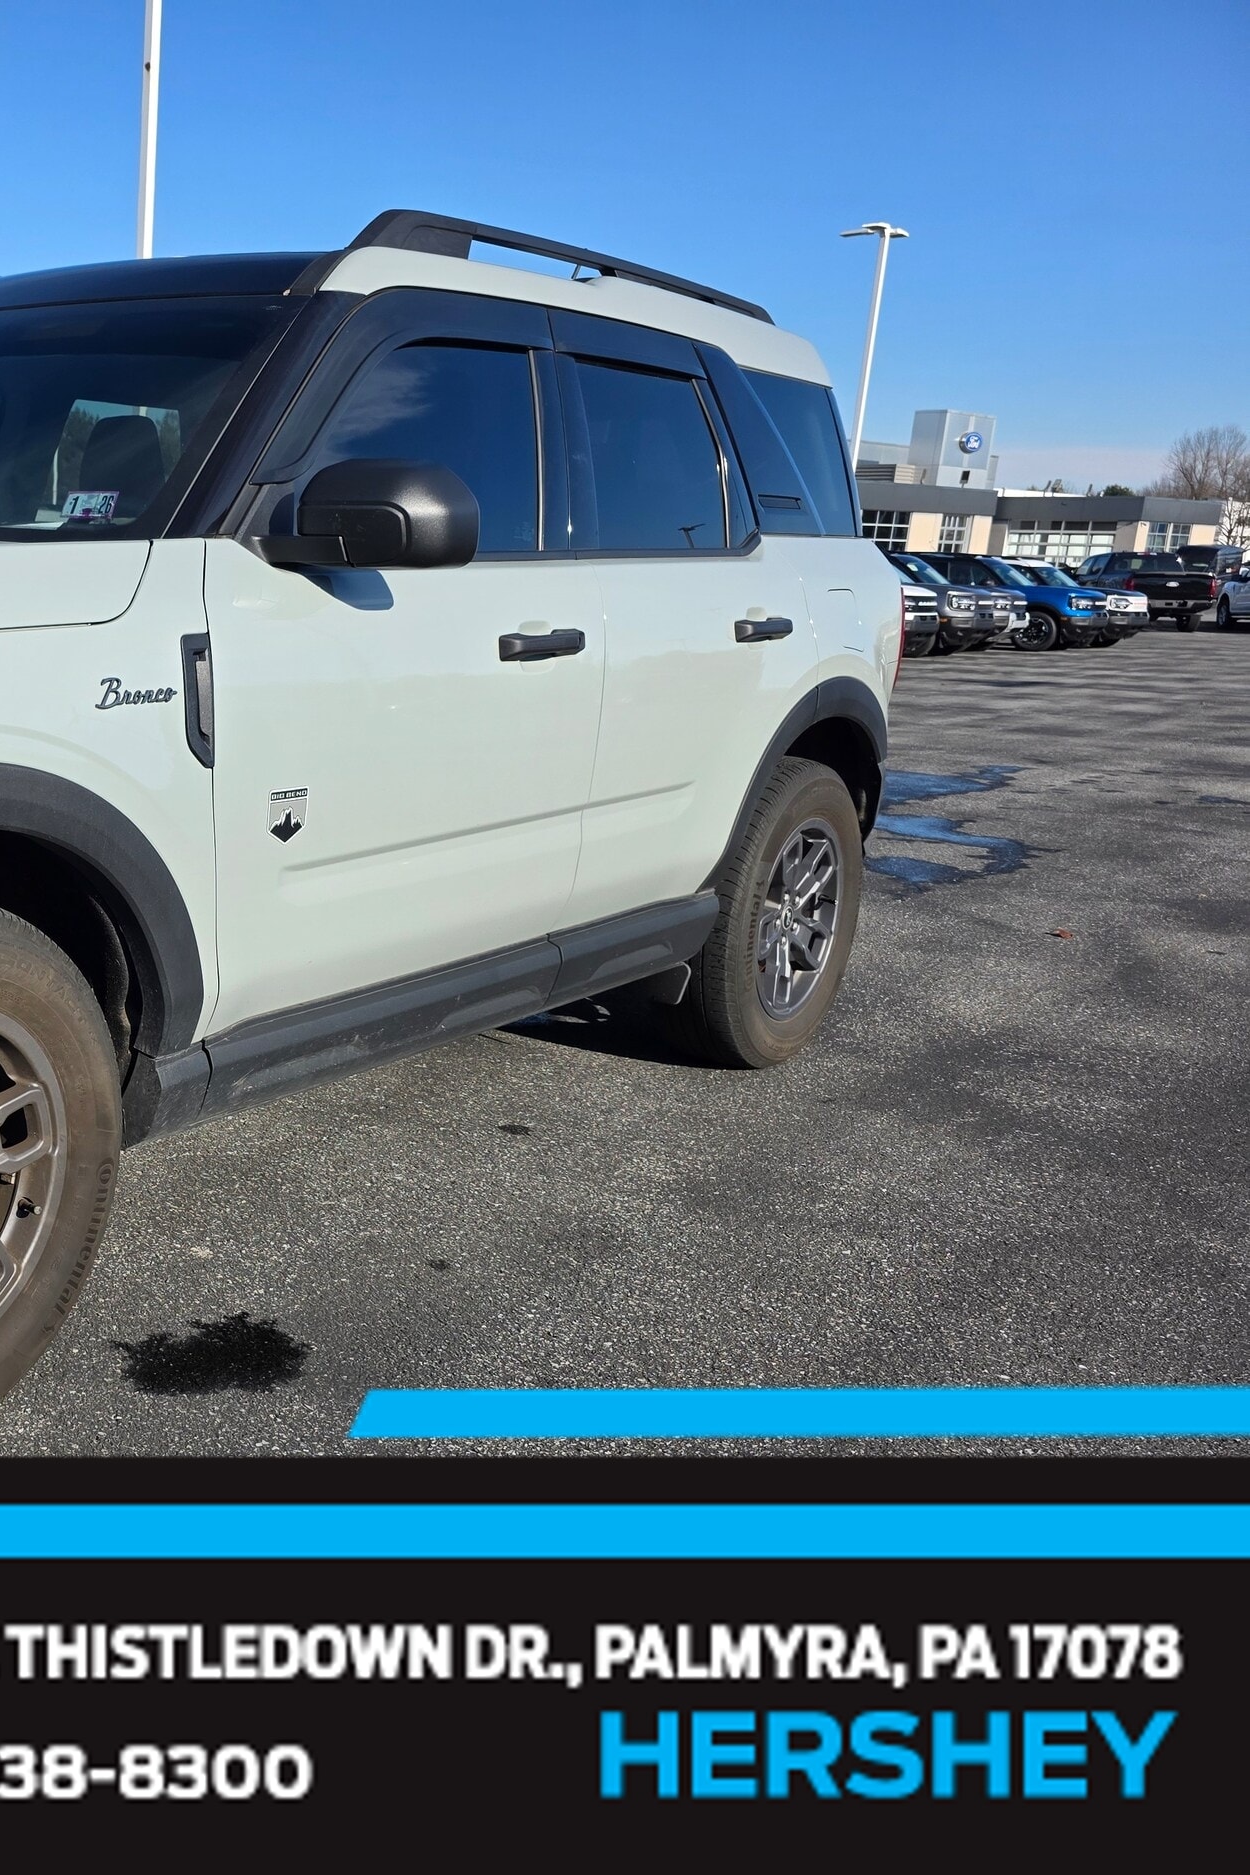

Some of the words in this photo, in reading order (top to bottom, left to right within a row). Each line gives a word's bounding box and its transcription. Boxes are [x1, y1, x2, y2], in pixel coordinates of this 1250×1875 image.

[98, 495, 115, 514] 26
[95, 677, 178, 710] Bronco
[54, 1157, 115, 1315] Continental
